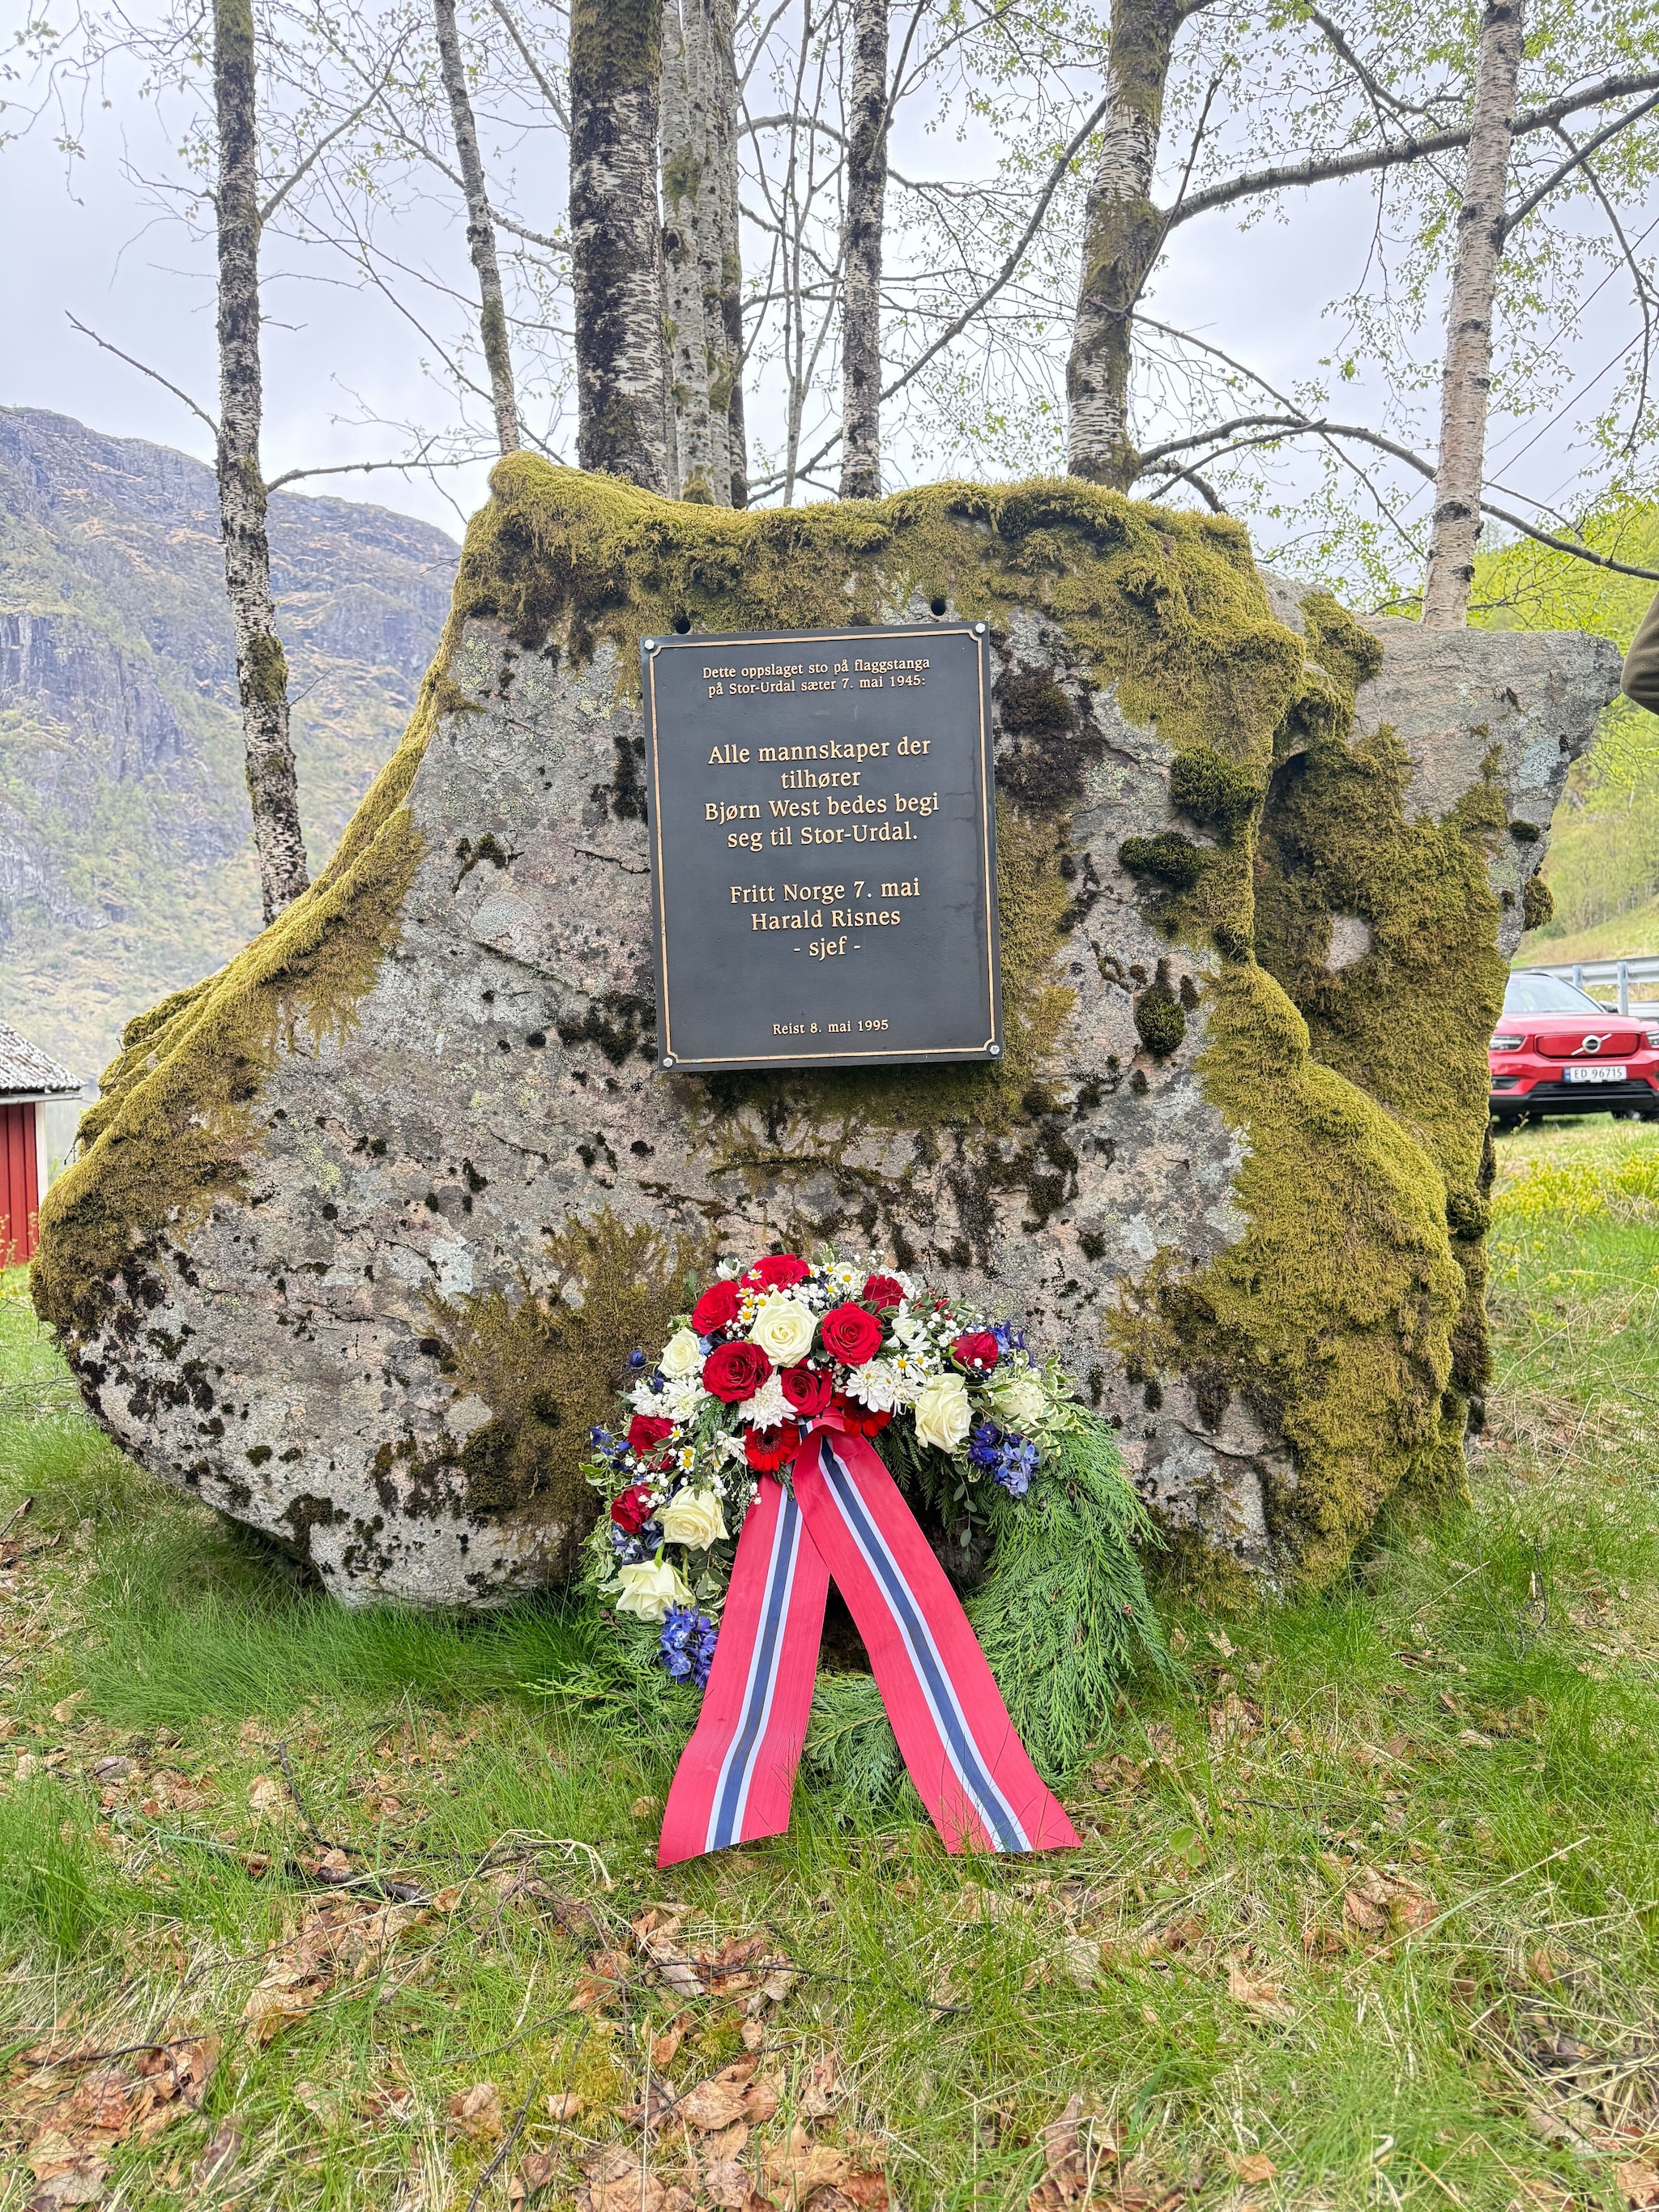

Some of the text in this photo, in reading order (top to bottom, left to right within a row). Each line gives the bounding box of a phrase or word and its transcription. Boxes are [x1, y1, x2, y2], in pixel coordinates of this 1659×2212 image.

[702, 658, 930, 680] Dette oppslaget sto på flaggstanga
[708, 674, 926, 698] på Stor-Urdal sæter 7. mai 1945:
[707, 736, 932, 765] Alle mannskaper der
[780, 769, 861, 790] tilhører
[705, 792, 940, 825] Bjørn West bedes begi
[727, 820, 919, 852] seg til Stor-Urdal.
[730, 877, 921, 906] Fritt Norge 7. mai
[751, 908, 902, 931] Harald Risnes
[808, 936, 848, 961] sjef
[772, 1019, 889, 1035] Reist 8. mai 1995
[1574, 1068, 1623, 1078] ED 96715
